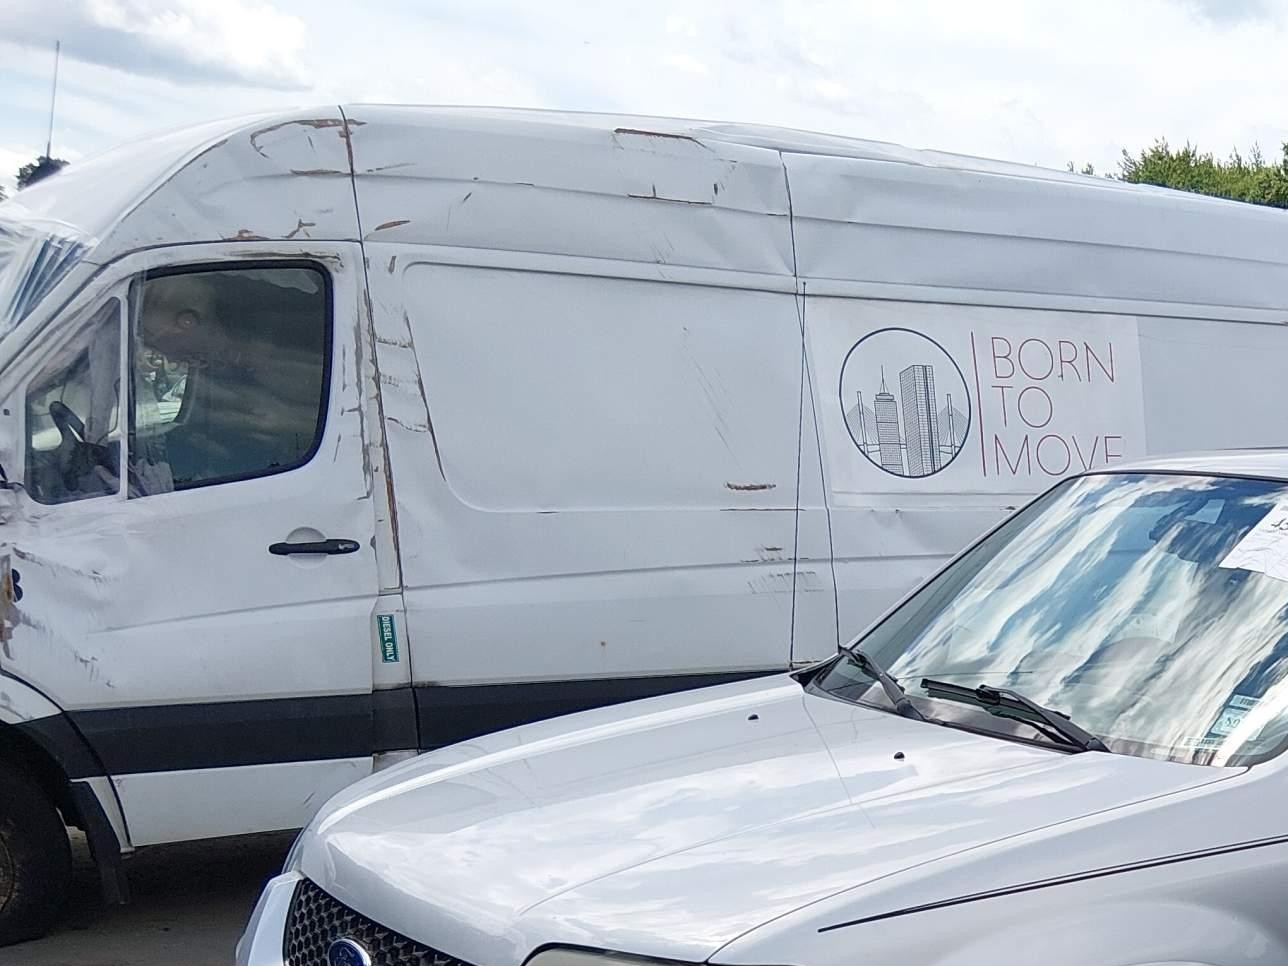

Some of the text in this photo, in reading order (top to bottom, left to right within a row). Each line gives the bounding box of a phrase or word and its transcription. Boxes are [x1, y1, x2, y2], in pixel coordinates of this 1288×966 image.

[991, 336, 1115, 383] BORN
[991, 385, 1053, 428] TO
[993, 433, 1123, 476] MOVE
[381, 616, 396, 661] DIESEL ONLY
